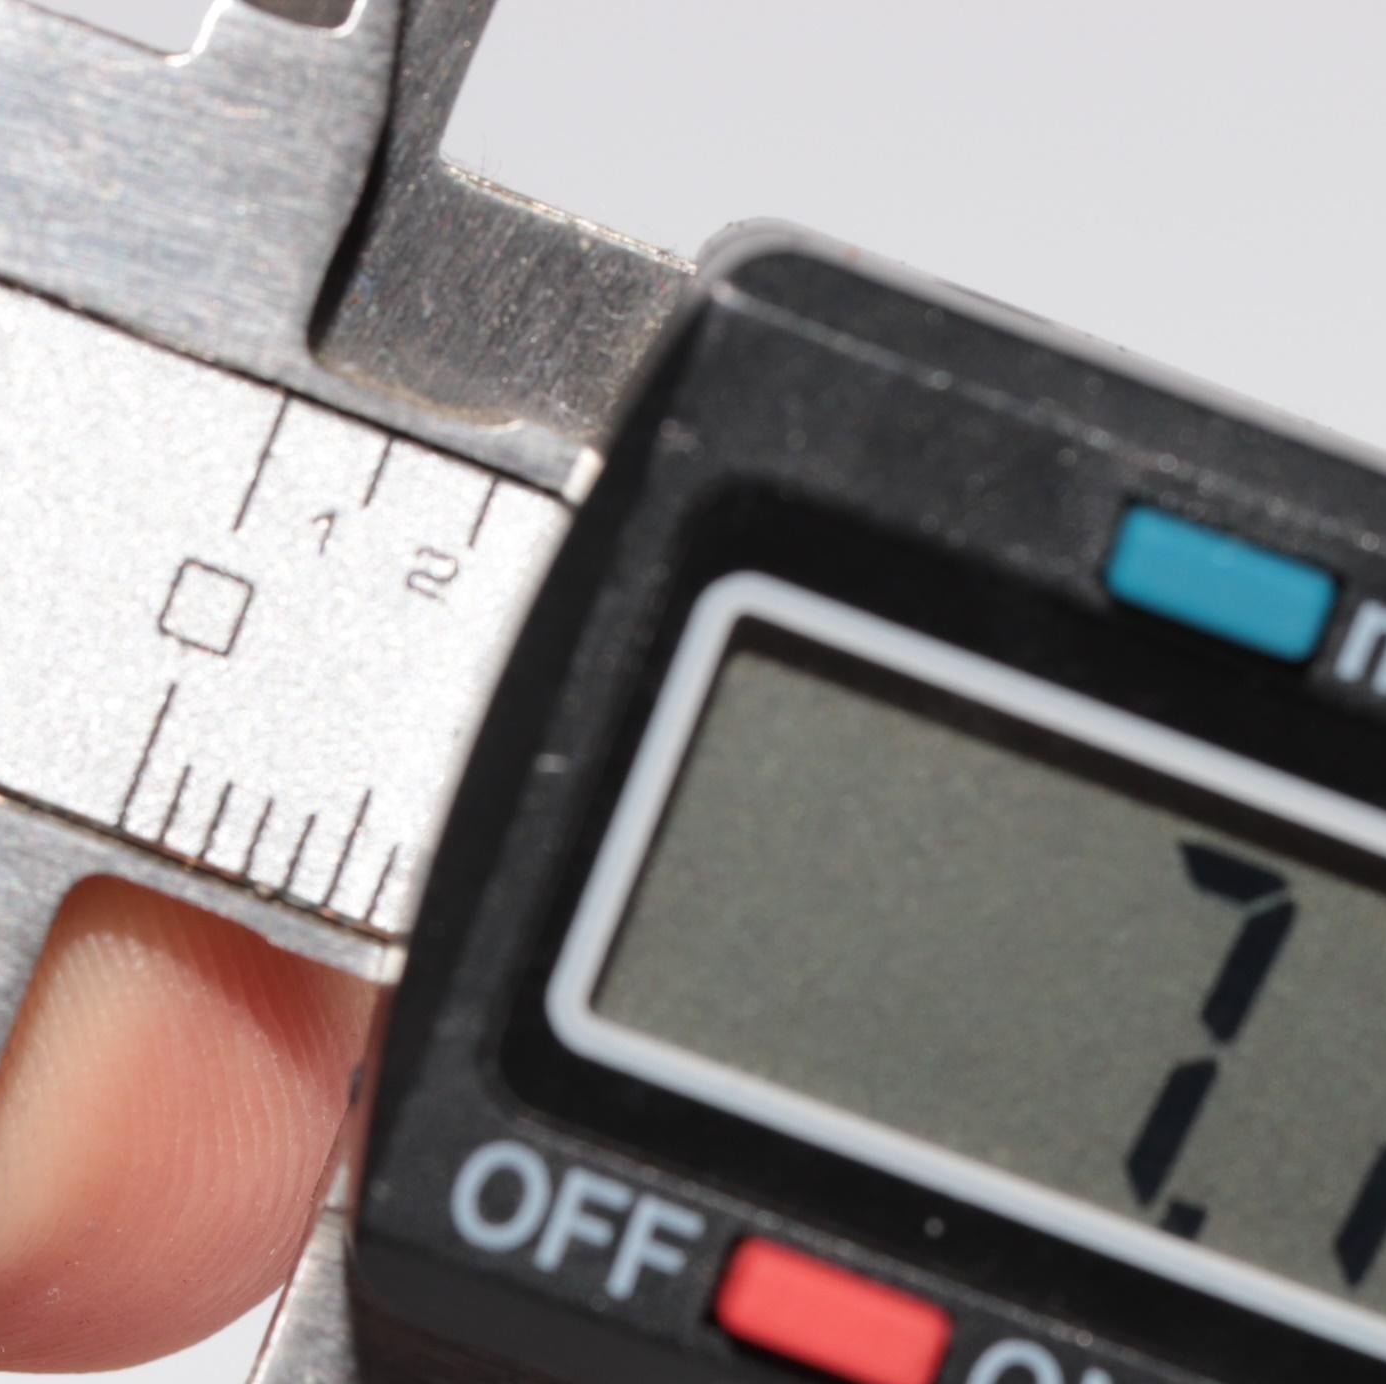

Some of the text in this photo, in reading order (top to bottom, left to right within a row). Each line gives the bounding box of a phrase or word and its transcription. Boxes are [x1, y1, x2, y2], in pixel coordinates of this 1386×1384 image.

[157, 556, 255, 658] 0
[311, 510, 460, 602] 1 2
[451, 1141, 705, 1299] OFF
